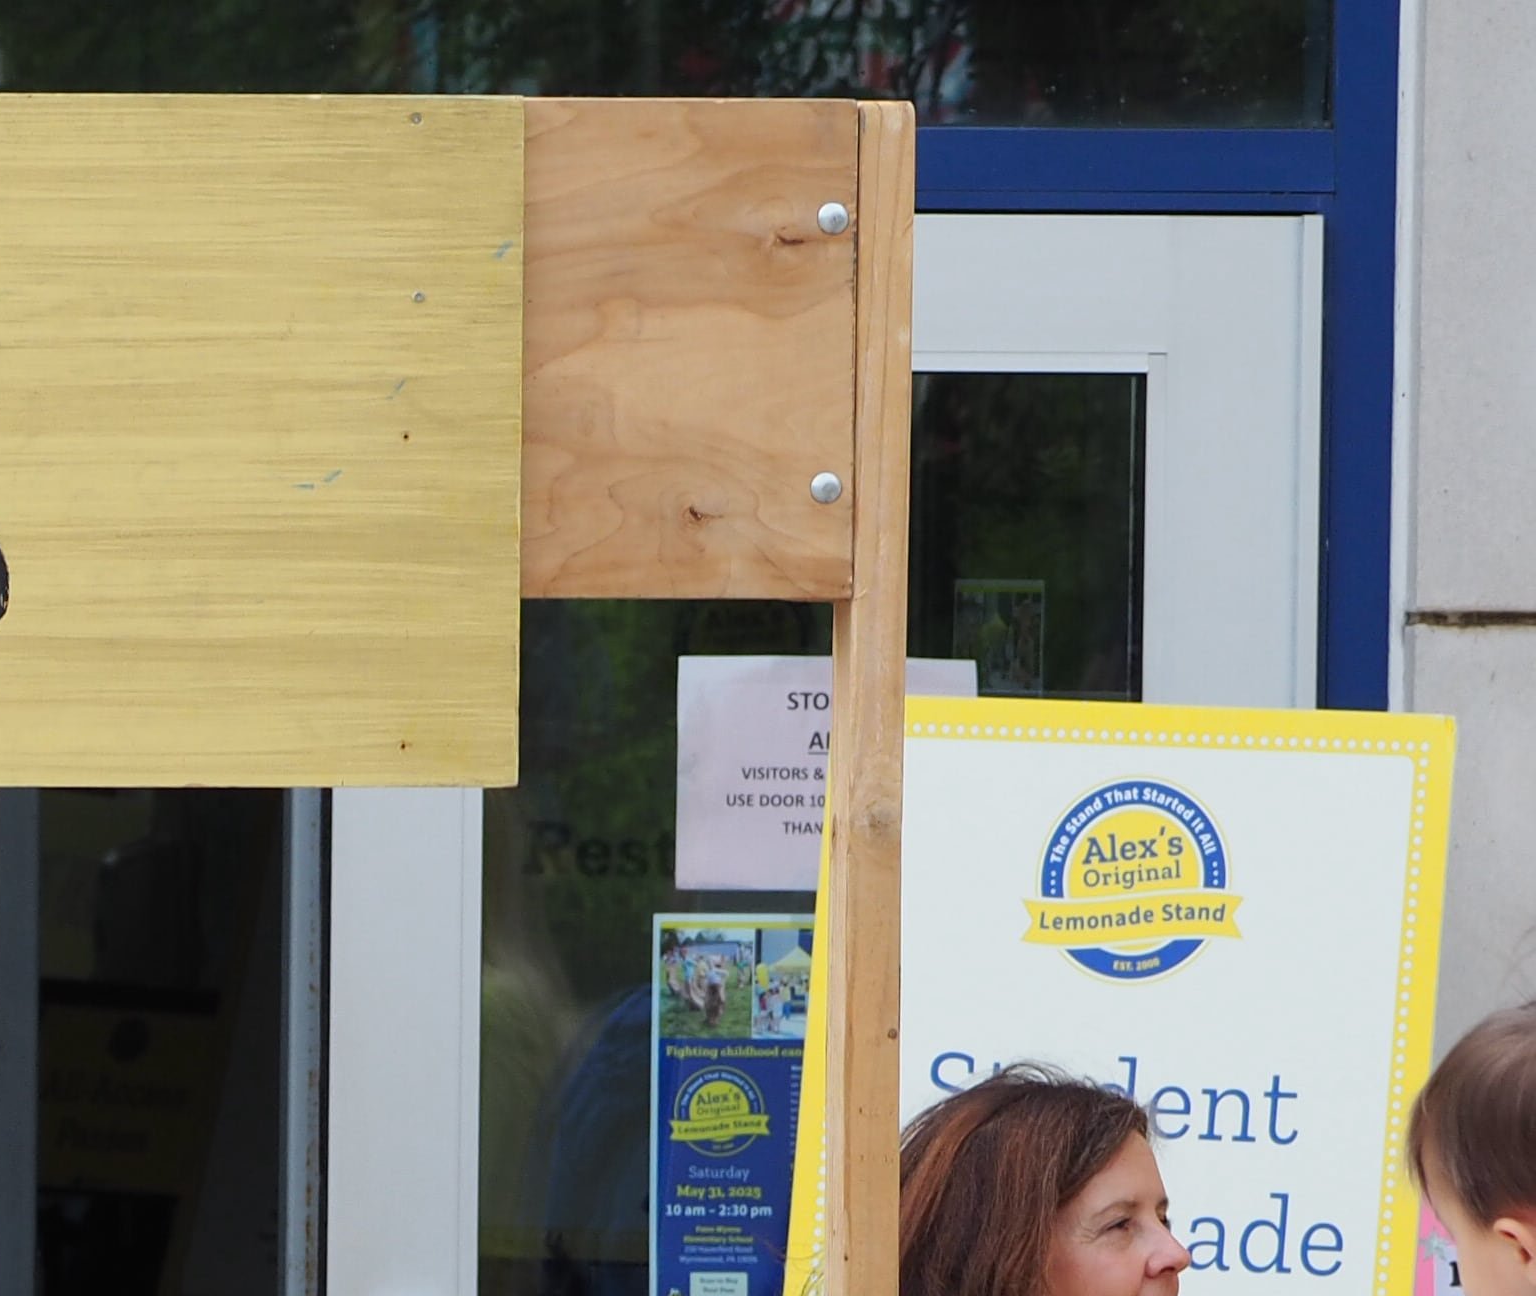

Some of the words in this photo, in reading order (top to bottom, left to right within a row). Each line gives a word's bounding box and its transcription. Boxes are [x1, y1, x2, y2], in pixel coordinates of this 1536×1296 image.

[787, 692, 830, 711] STO
[741, 766, 809, 781] VISITORS
[813, 767, 825, 780] &
[725, 794, 755, 808] USE
[759, 794, 805, 808] DOOR
[782, 821, 824, 835] THAN
[1049, 834, 1071, 864] The
[1064, 797, 1104, 834] Stand
[1103, 786, 1140, 806] That
[1142, 786, 1196, 822] Started
[1189, 811, 1206, 834] It
[1198, 830, 1218, 857] All
[1081, 826, 1184, 866] Alex's
[1082, 859, 1182, 890] Original
[1039, 905, 1155, 932] Lemonade
[1161, 903, 1227, 923] Stand
[688, 1164, 751, 1181] Saturday
[677, 1183, 706, 1200] May
[665, 1203, 680, 1217] 10
[684, 1206, 706, 1217] am
[718, 1203, 749, 1217] 2:30
[750, 1206, 773, 1219] pm
